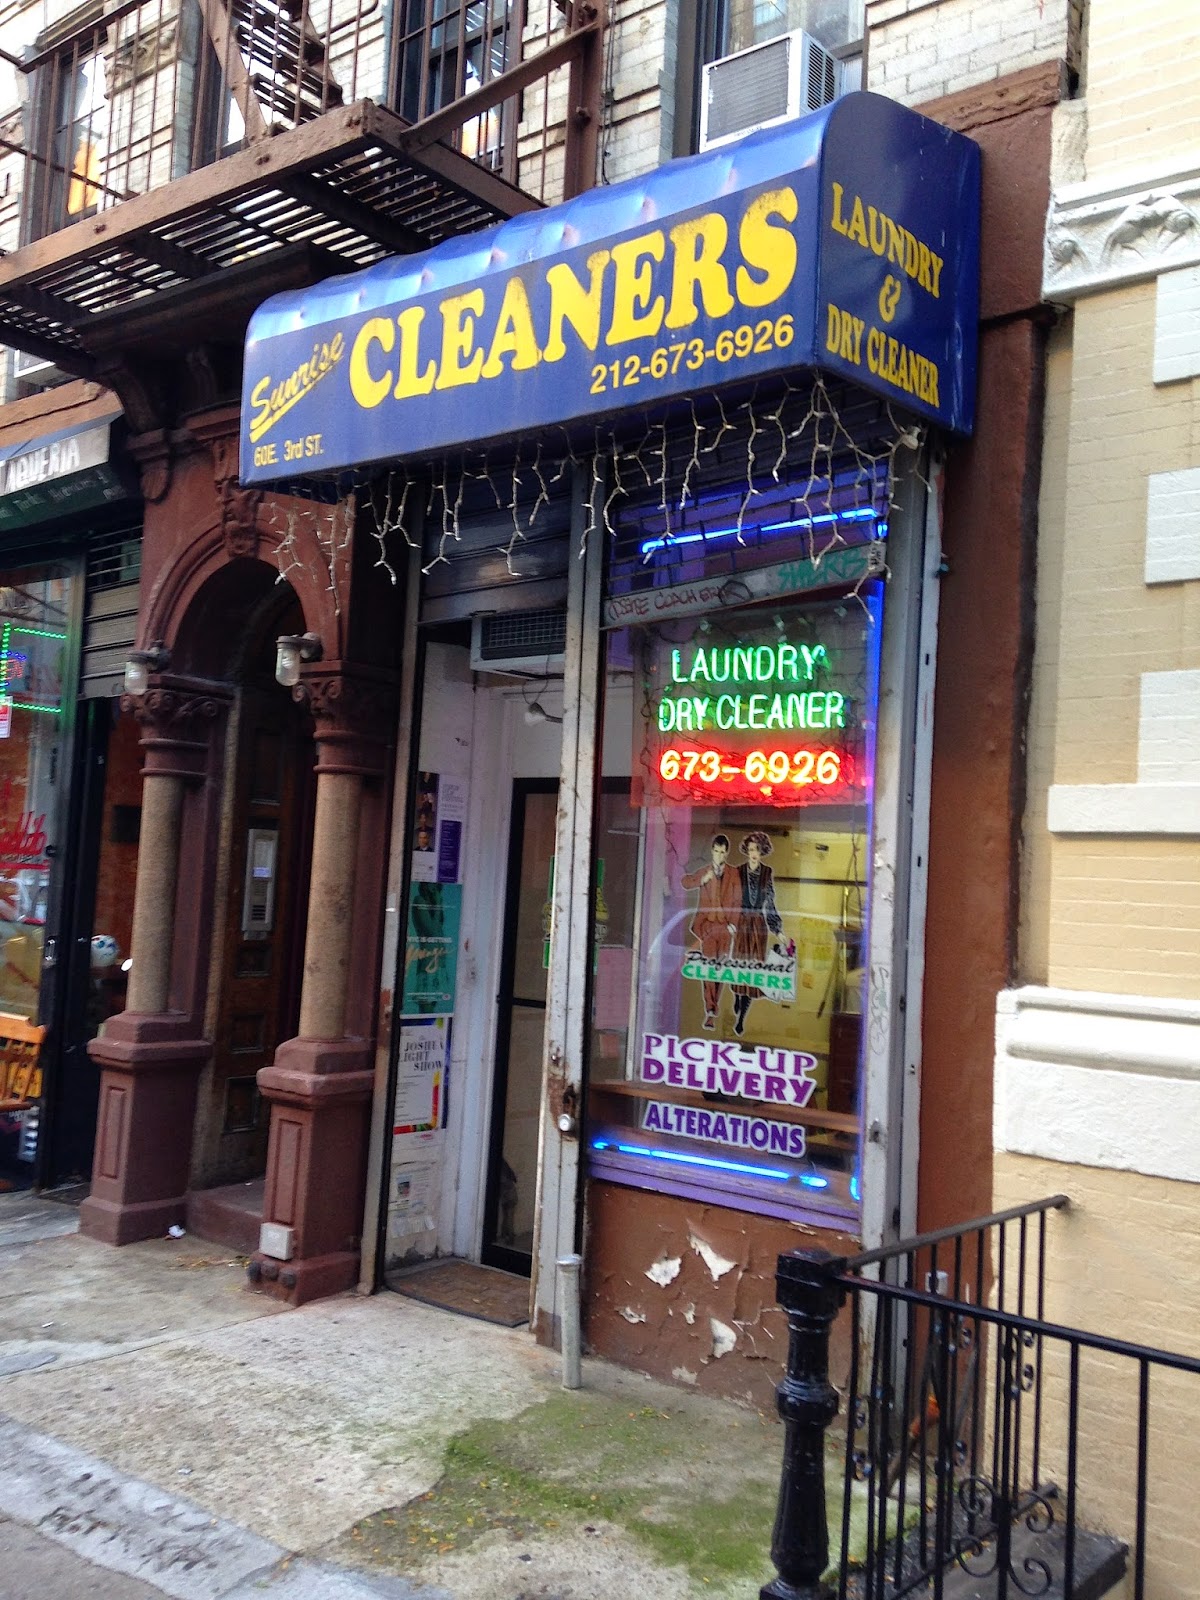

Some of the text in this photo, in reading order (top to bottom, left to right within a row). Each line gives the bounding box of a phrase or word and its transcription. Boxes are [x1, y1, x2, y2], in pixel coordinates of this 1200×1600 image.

[831, 182, 944, 299] LAUNDRY
[349, 186, 799, 409] CLEANERS
[878, 274, 902, 323] &
[590, 314, 795, 395] 212-673-6926
[826, 303, 940, 409] DRY CLEANER
[250, 331, 346, 432] Sunrise
[0, 438, 80, 495] AQUERIA
[284, 438, 303, 461] 3rd
[305, 434, 325, 456] ST.
[671, 644, 825, 683] LAUNDRY
[658, 690, 846, 732] DRY CLEANER
[659, 749, 841, 785] 673-6926
[681, 964, 793, 991] CLEANERS
[685, 951, 795, 974] Professional
[400, 1050, 430, 1063] IGHT
[413, 1060, 442, 1072] SHOW
[644, 1034, 815, 1077] PICK-UP
[642, 1057, 813, 1104] DELIVERY
[645, 1103, 804, 1155] ALTERATIONS
